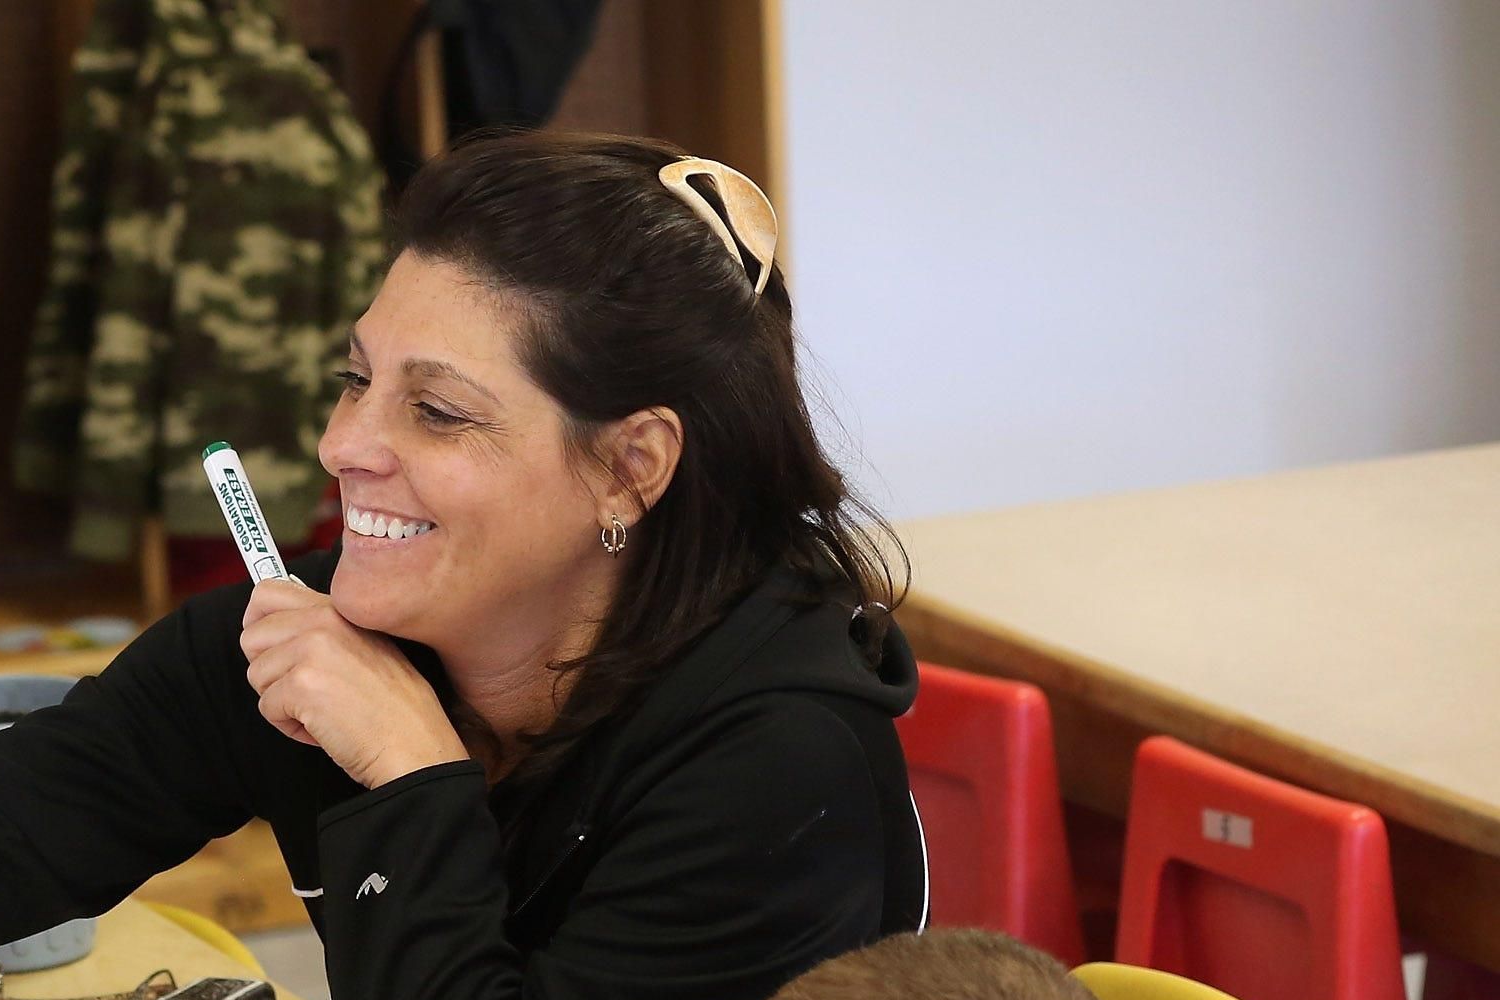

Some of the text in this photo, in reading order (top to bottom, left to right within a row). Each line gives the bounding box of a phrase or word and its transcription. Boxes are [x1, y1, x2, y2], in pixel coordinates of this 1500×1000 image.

[217, 482, 253, 553] COLORATIONS
[225, 471, 268, 551] DRY ERASE
